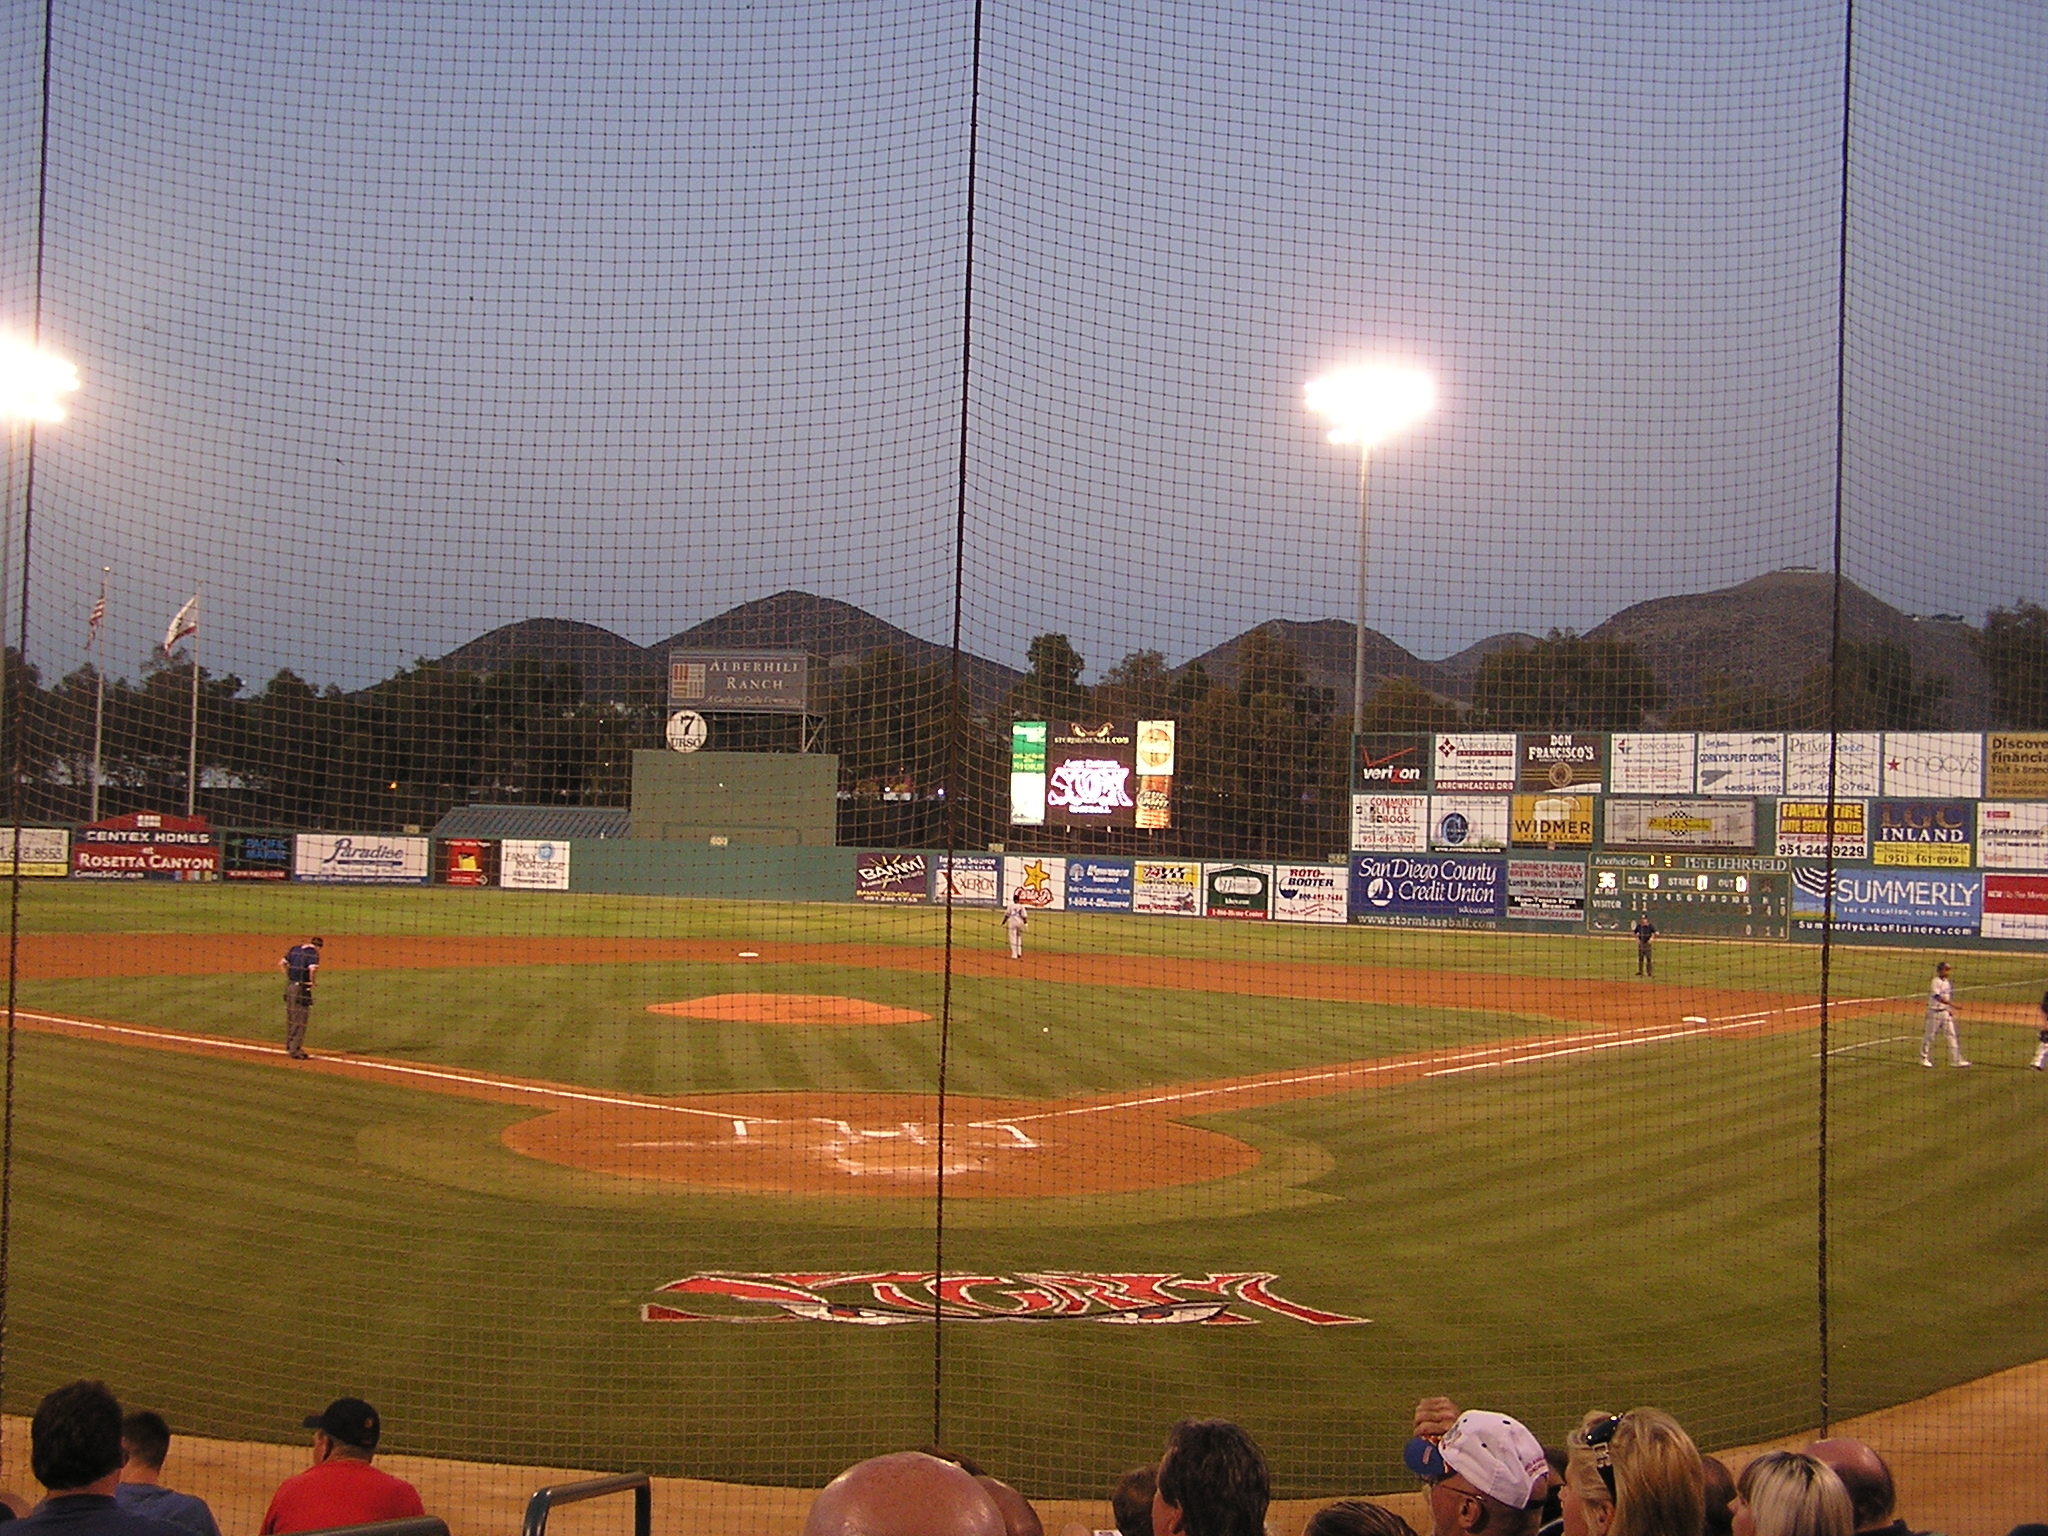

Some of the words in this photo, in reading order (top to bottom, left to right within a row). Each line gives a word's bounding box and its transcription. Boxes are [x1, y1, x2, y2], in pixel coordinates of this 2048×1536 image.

[727, 677, 783, 690] RANCH
[680, 715, 695, 736] 7
[671, 737, 702, 748] URSO
[1550, 734, 1573, 746] DON
[1528, 746, 1595, 760] FRANCISCO'S
[1731, 754, 1748, 762] PEST
[1749, 754, 1781, 763] CONTROL
[1363, 765, 1420, 783] verizon
[1370, 797, 1424, 806] COMMUNITY
[1377, 806, 1409, 815] LITTLE
[1782, 804, 1828, 818] FAMILY
[1833, 804, 1862, 819] TIRE
[1879, 804, 1964, 829] LGC
[1382, 815, 1411, 823] BOOK
[1515, 820, 1590, 834] WIDMER
[1780, 819, 1801, 833] AUTO
[1802, 820, 1829, 833] SERVIC
[1833, 820, 1863, 834] CENTER
[86, 831, 150, 842] CENTEX
[155, 833, 210, 844] HOMES
[1882, 828, 1964, 842] INLAND
[323, 838, 404, 864] Paradise
[79, 853, 146, 868] ROSETTA
[150, 855, 214, 869] CANYON
[858, 855, 925, 880] BAMM!
[968, 856, 996, 865] Source
[1685, 857, 1716, 868] PETE
[1718, 857, 1751, 869] LEHR
[1752, 860, 1787, 871] FIELD
[1143, 865, 1164, 879] 74
[1290, 869, 1325, 877] ROTO-
[1358, 858, 1391, 877] San
[1391, 858, 1438, 883] Diego
[1440, 860, 1497, 885] County
[959, 877, 995, 890] XEROX
[1288, 878, 1334, 887] BOOTER
[1627, 876, 1647, 885] BALL
[1668, 877, 1696, 887] STRIKE
[1718, 879, 1735, 888] OUT
[1398, 880, 1445, 901] Credit
[1447, 882, 1495, 903] Union
[1605, 888, 1619, 896] BAT
[1836, 879, 1979, 907] SUMMERLY
[1592, 900, 1622, 909] VISITOR
[1632, 901, 1637, 911] 1
[1642, 901, 1648, 911] 1
[1746, 905, 1752, 915] 3
[1870, 908, 1912, 916] vacation,
[1357, 914, 1496, 930] www.stormbaseball.com
